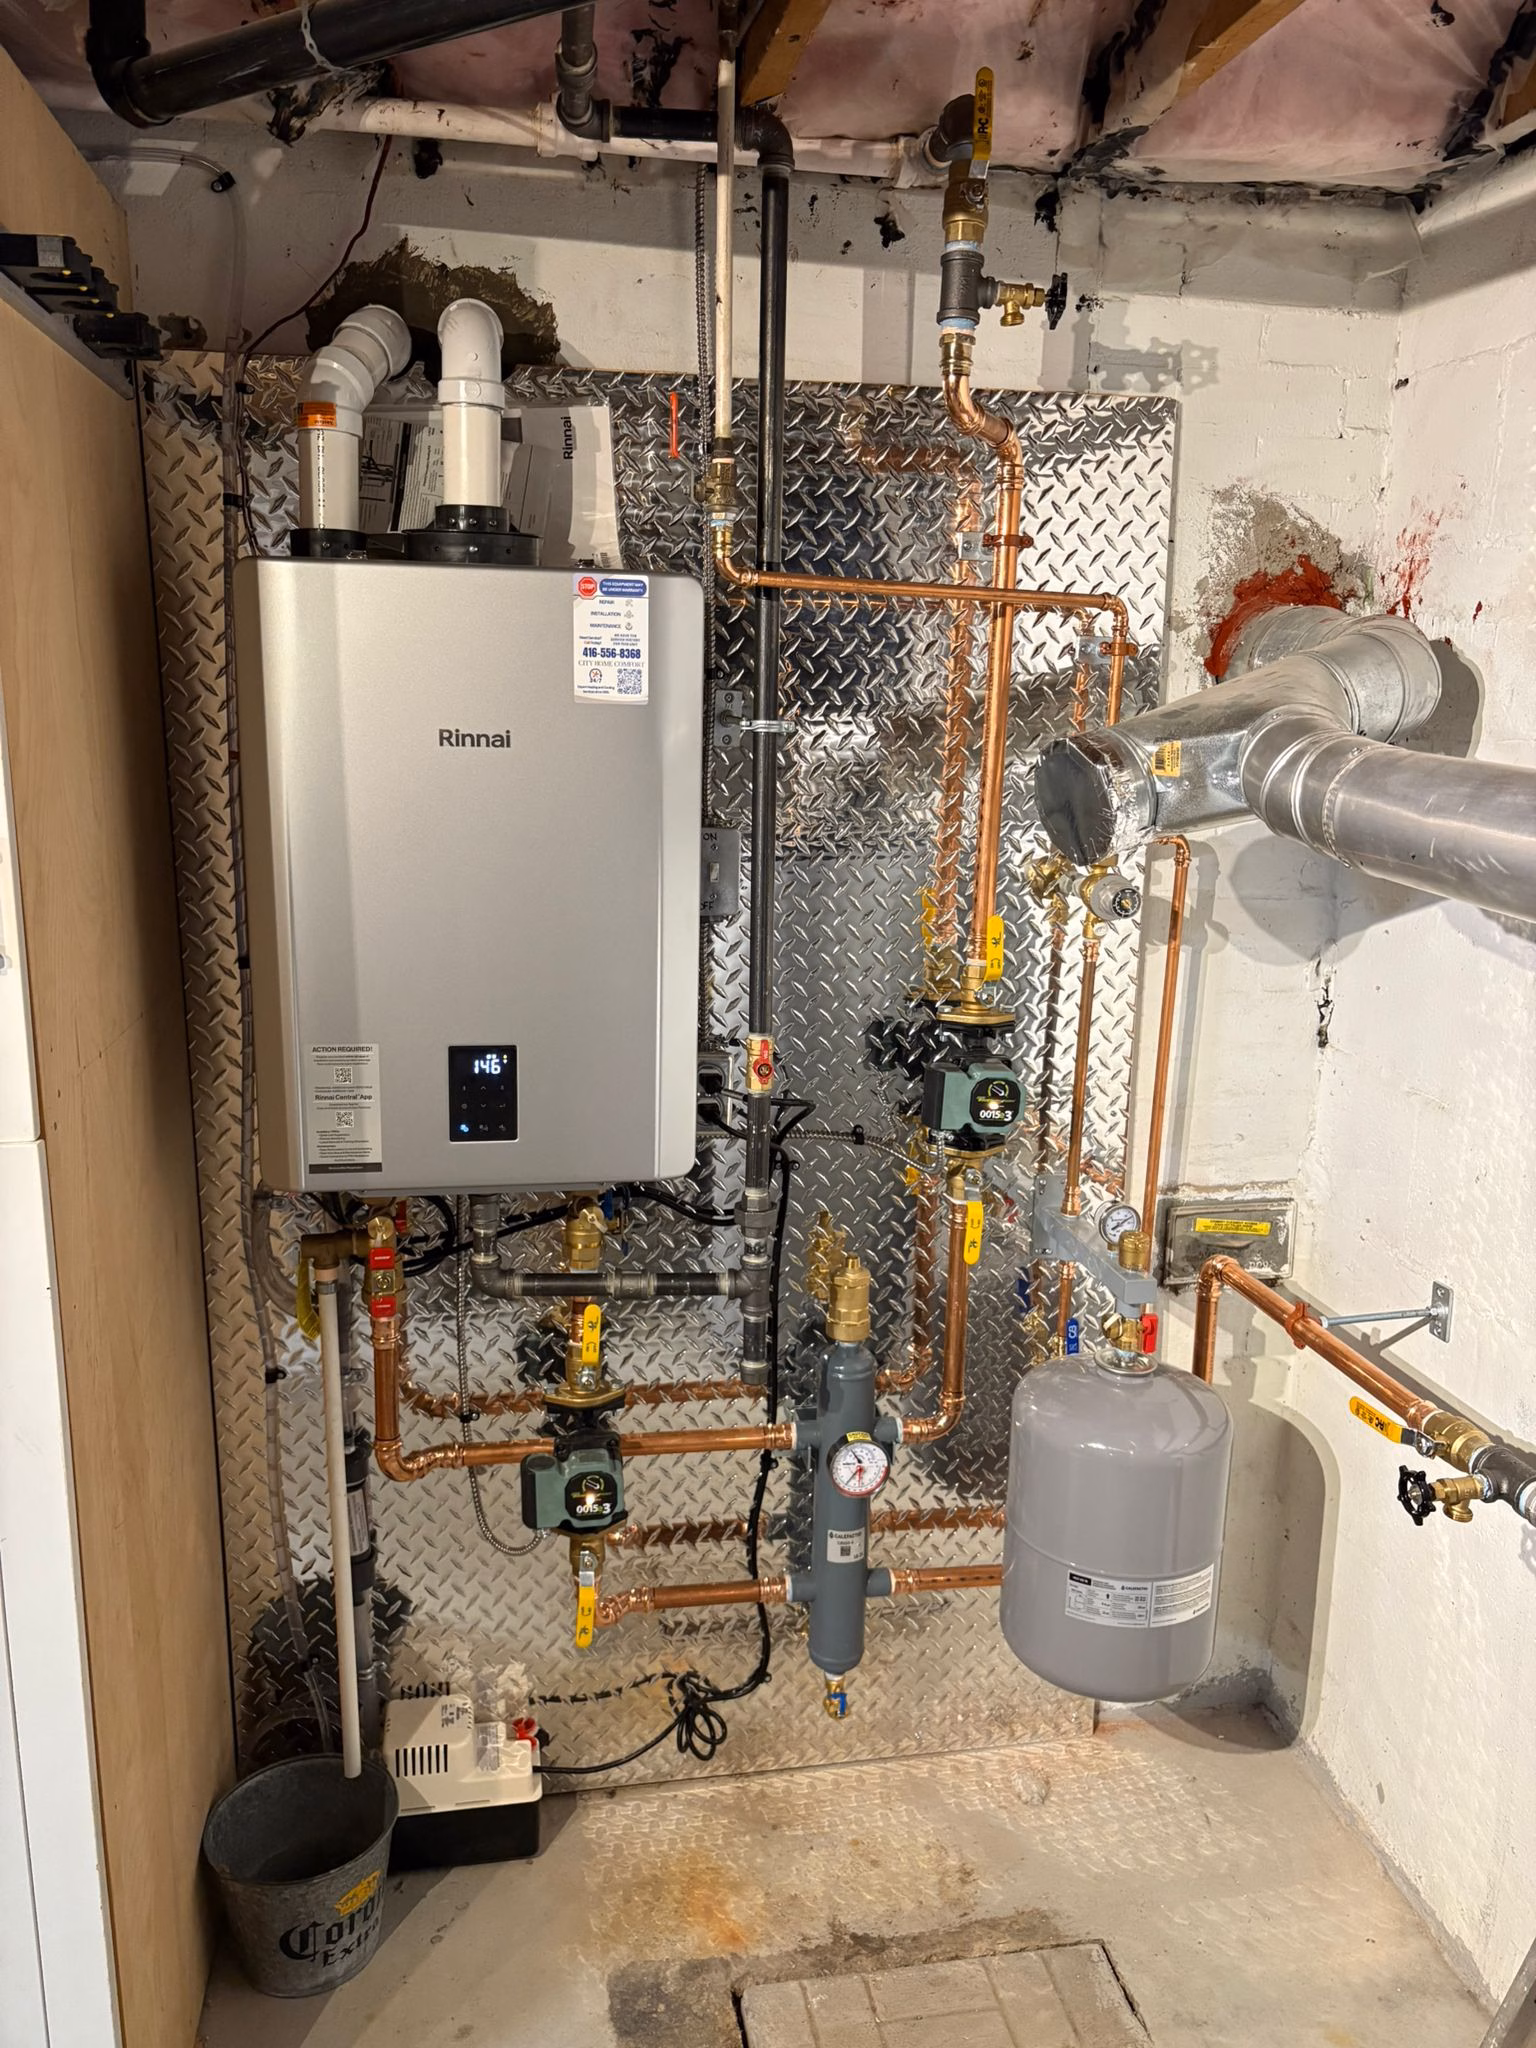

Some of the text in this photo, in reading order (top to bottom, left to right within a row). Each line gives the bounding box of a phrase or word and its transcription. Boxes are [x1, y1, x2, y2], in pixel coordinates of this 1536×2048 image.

[560, 416, 574, 460] Rinnai
[582, 647, 641, 659] 416-556-8368
[439, 728, 511, 748] Rinnai
[703, 832, 717, 840] ON
[474, 1058, 501, 1074] 146
